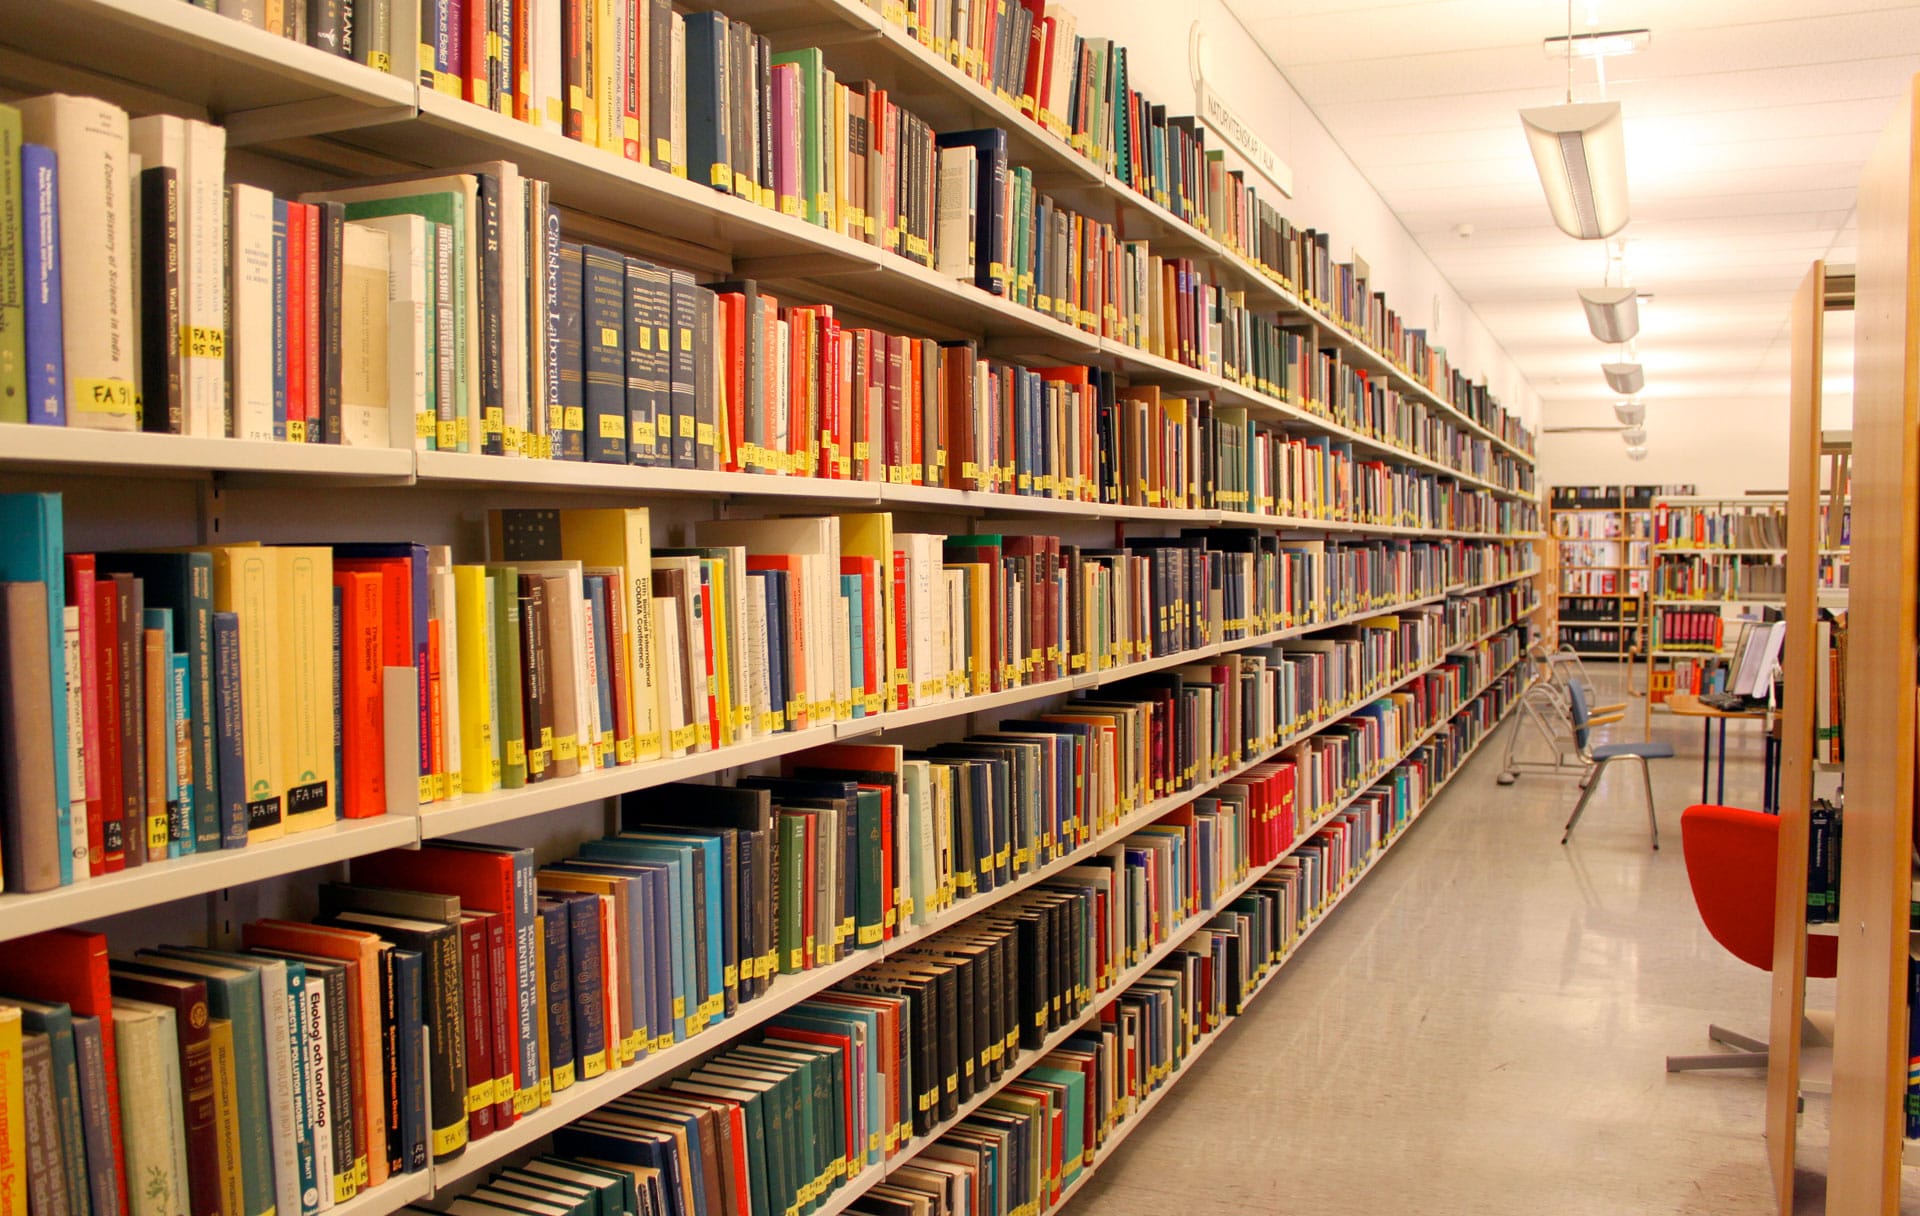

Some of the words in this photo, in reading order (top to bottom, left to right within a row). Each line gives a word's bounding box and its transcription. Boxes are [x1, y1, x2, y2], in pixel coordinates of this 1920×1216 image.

[343, 6, 353, 55] PLANET
[503, 0, 511, 22] ank
[503, 24, 511, 37] of
[440, 33, 448, 66] Belief
[503, 38, 511, 90] America
[104, 163, 114, 207] Concise
[168, 179, 177, 222] SCIENCE
[105, 211, 116, 250] History
[169, 227, 177, 239] IN
[108, 256, 117, 269] of
[168, 243, 177, 273] INDIA
[439, 227, 450, 303] MENDELSSOHN
[548, 214, 560, 306] Carlsberg
[109, 270, 118, 314] Science
[111, 318, 119, 329] in
[193, 329, 206, 341] FA
[210, 331, 223, 343] FA
[440, 308, 450, 357] WESTERN
[111, 333, 120, 363] India
[549, 311, 561, 404] Laborator
[93, 386, 113, 403] FA
[635, 579, 643, 615] CODATA
[200, 642, 207, 653] OF
[365, 627, 371, 637] of
[586, 606, 596, 685] EXPEDITIONS
[637, 618, 645, 669] Conference
[229, 630, 239, 678] WILDLIFE
[644, 633, 652, 687] International
[175, 668, 187, 743] Forureningens
[202, 680, 210, 723] RESEARCH
[231, 681, 242, 757] PHOTOGRAPHY
[203, 725, 210, 737] ON
[204, 738, 212, 791] TECHNOLOGY
[252, 805, 265, 817] FA
[295, 789, 309, 801] FA
[442, 938, 450, 967] AND
[519, 927, 529, 987] TWENTIETH
[527, 925, 535, 968] SCIENCE
[444, 969, 453, 1018] SOCIETY
[529, 969, 535, 981] IN
[287, 994, 297, 1034] ASPECTS
[299, 991, 308, 1044] STATISTICAL
[309, 992, 322, 1041] Ekologi
[335, 973, 348, 1060] Environmental
[453, 990, 462, 1068] TECHNOLOGY
[521, 992, 531, 1039] CENTURY
[289, 1036, 297, 1044] of
[313, 1044, 324, 1066] och
[24, 1065, 37, 1081] of
[290, 1046, 301, 1093] POLLUTION
[339, 1063, 350, 1117] Pollution
[25, 1083, 40, 1144] Science
[303, 1063, 313, 1128] MATHEMATICAL
[314, 1068, 326, 1128] landskap
[294, 1095, 304, 1143] PROBLEMS
[445, 1134, 455, 1145] FA
[31, 1145, 46, 1173] and
[342, 1120, 353, 1167] Control
[304, 1155, 312, 1179] PRATT
[343, 1173, 353, 1183] FA
[2, 1174, 16, 1216] Scien
[35, 1175, 49, 1216] Techn
